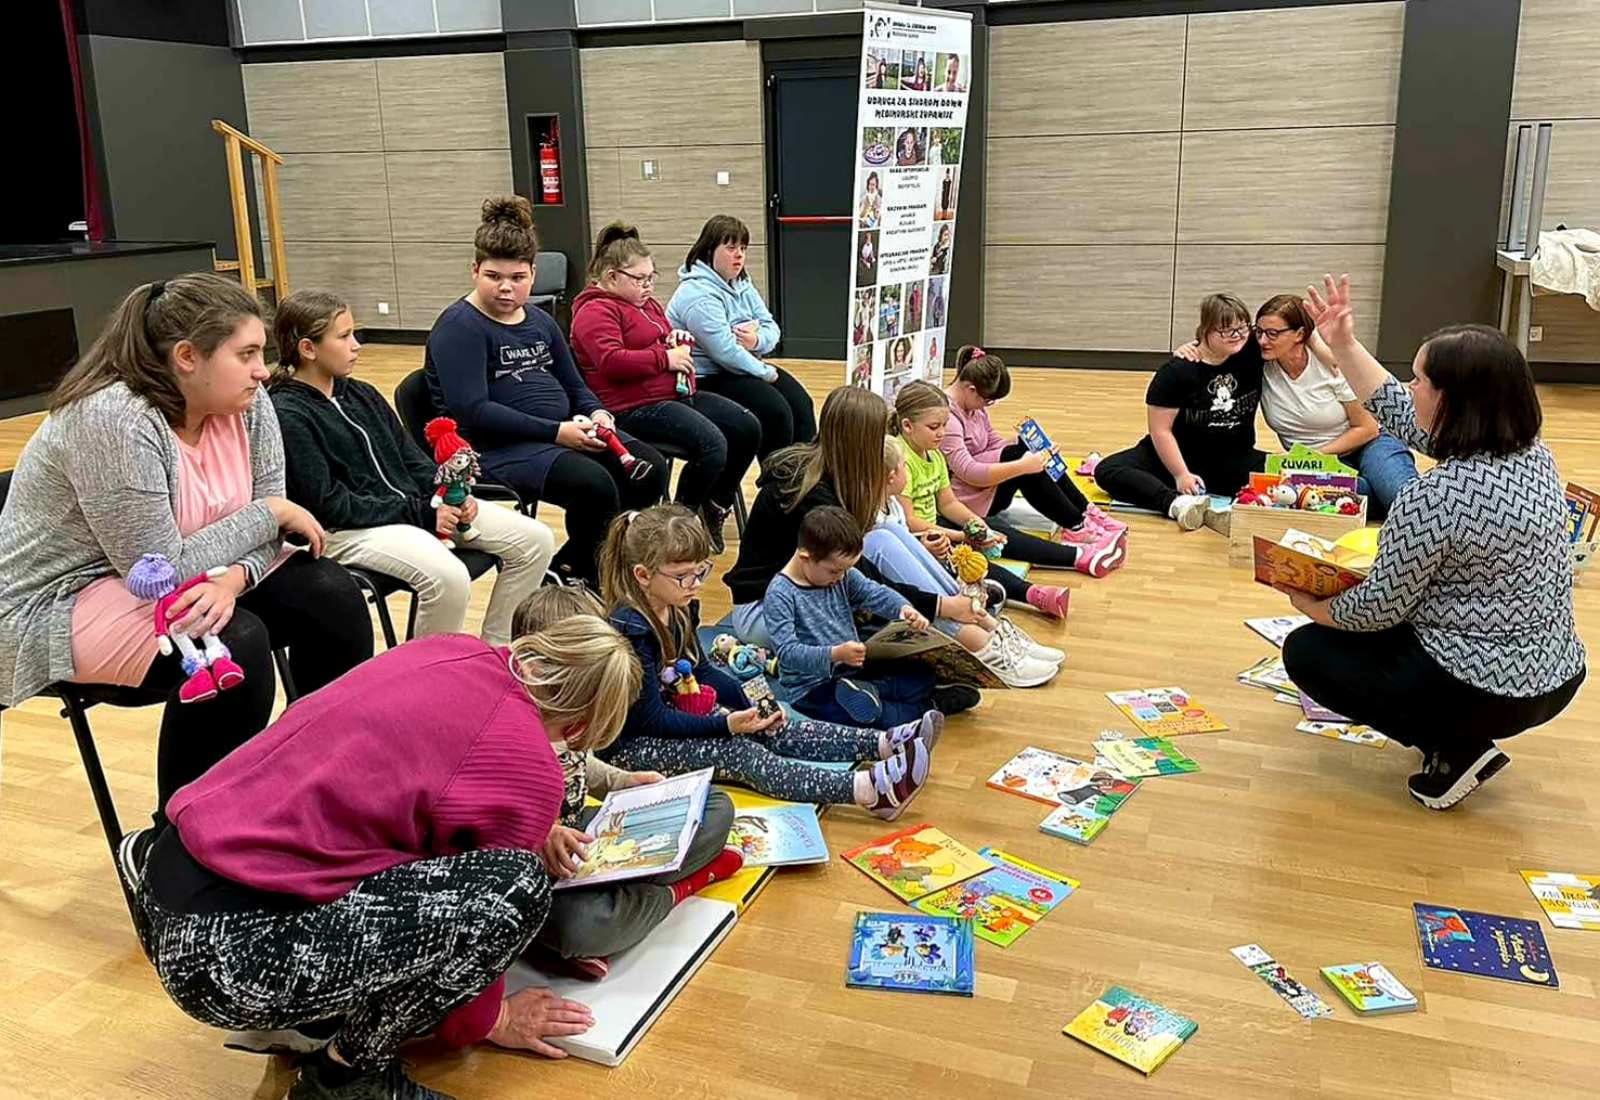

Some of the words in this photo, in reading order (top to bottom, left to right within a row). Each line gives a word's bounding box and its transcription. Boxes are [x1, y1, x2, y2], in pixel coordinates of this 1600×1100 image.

[867, 96, 896, 106] UDRUGA
[897, 97, 907, 106] ZA
[908, 97, 939, 107] SINDROM
[506, 349, 532, 359] WAKE
[531, 345, 545, 356] UP
[1281, 459, 1323, 469] ČUVARI
